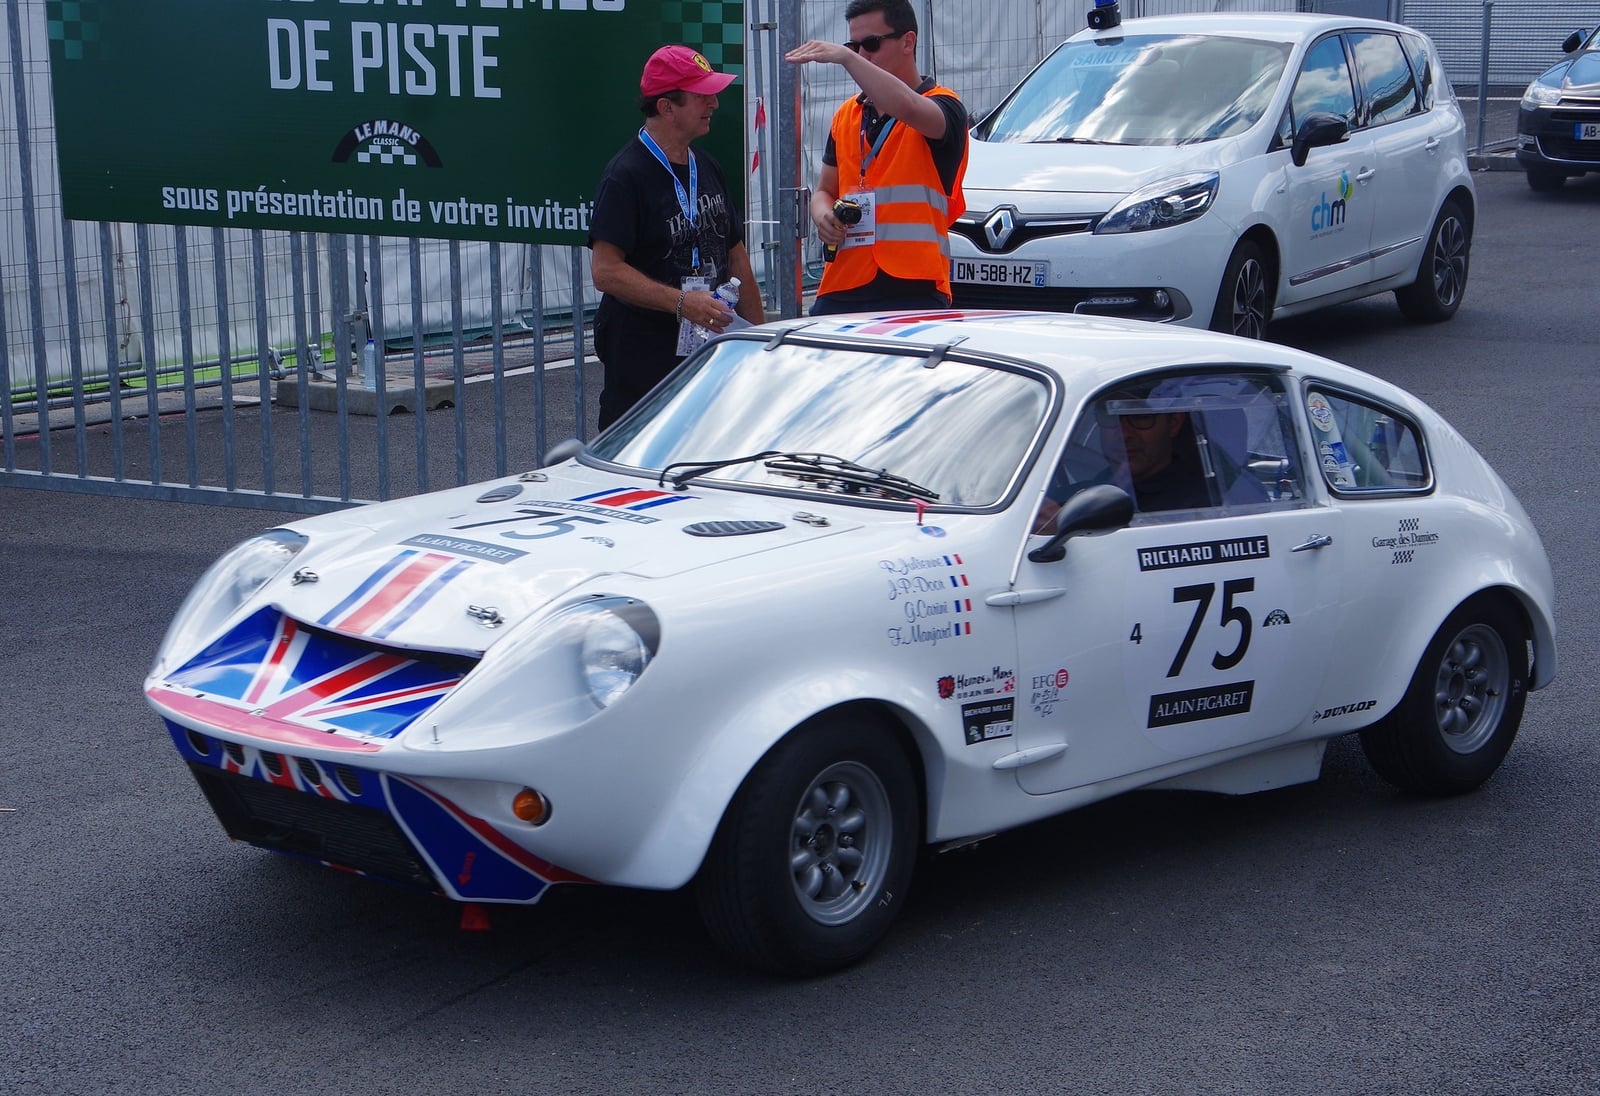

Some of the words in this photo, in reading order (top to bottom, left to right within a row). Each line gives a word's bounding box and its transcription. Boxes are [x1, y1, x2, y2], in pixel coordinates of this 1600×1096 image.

[267, 18, 333, 91] DE
[351, 21, 502, 98] PISTE
[1073, 51, 1119, 65] SAMU
[354, 122, 373, 143] LE
[373, 120, 420, 145] MANS
[372, 137, 400, 146] CLASSIC
[162, 186, 219, 211] sous
[226, 185, 384, 220] présentation
[391, 188, 421, 222] de
[428, 197, 498, 226] votre
[1311, 191, 1346, 231] chm
[957, 262, 1032, 284] DN-588-HZ
[1035, 275, 1045, 286] 72
[449, 509, 609, 540] 75
[414, 536, 457, 548] ALAIN
[453, 541, 516, 559] FIGARET
[1372, 536, 1397, 549] Garage
[1398, 533, 1410, 545] des
[1411, 531, 1439, 543] Damiers
[1140, 545, 1214, 567] RICHARD
[1219, 540, 1266, 558] MILLE
[1130, 623, 1143, 644] 4
[1166, 577, 1255, 678] 75
[993, 666, 1013, 681] Mans
[1032, 674, 1055, 690] EFG
[1155, 700, 1196, 718] ALAIN
[1195, 690, 1248, 711] FIGARET
[1321, 700, 1377, 719] DUNLOP
